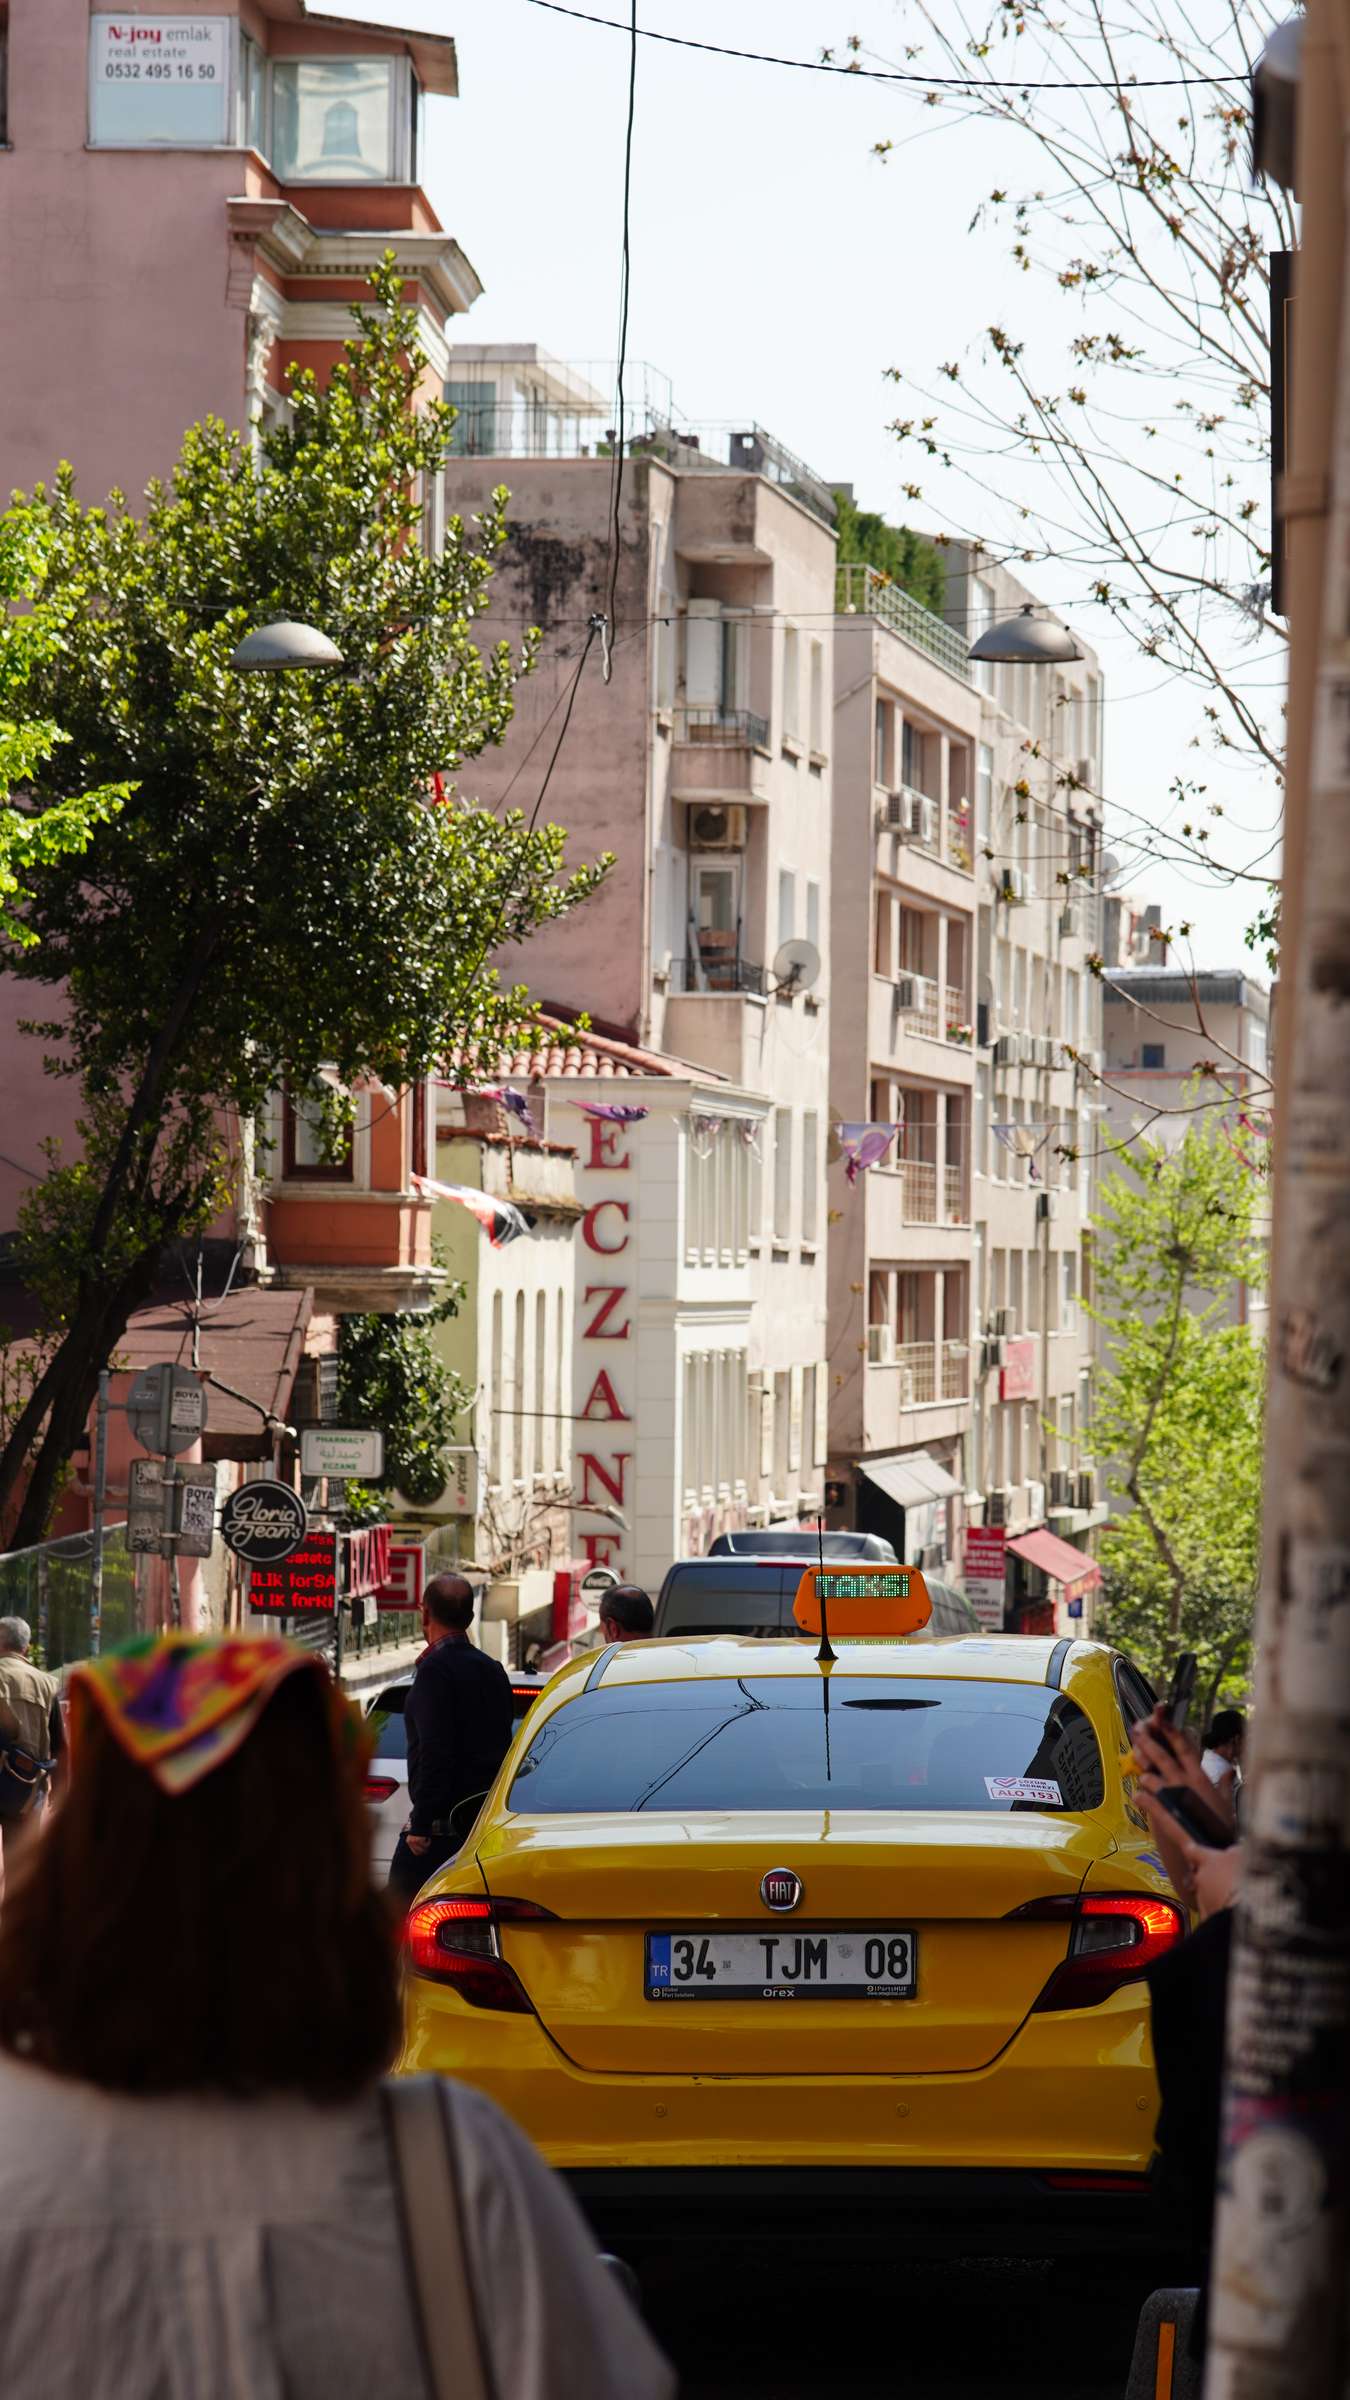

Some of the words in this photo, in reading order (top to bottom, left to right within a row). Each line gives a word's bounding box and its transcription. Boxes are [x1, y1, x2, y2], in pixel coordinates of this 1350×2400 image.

[108, 26, 162, 43] N-joy
[166, 26, 212, 41] emlak
[108, 47, 137, 58] real
[142, 48, 187, 58] estate
[105, 63, 141, 78] 0532
[146, 64, 172, 79] 495
[178, 64, 193, 79] 16
[198, 65, 215, 79] 50
[315, 1436, 366, 1444] PHARMACY
[322, 1462, 357, 1470] ECZANE
[186, 1488, 214, 1500] BOYA
[229, 1497, 297, 1525] Gloria
[231, 1524, 301, 1548] Jean's
[1029, 1791, 1054, 1800] 153
[769, 1881, 793, 1900] FIAT
[673, 1939, 717, 1981] 34
[759, 1938, 828, 1980] TJM
[864, 1938, 908, 1979] 08
[652, 1964, 668, 1977] TR
[763, 1988, 794, 1998] Orex
